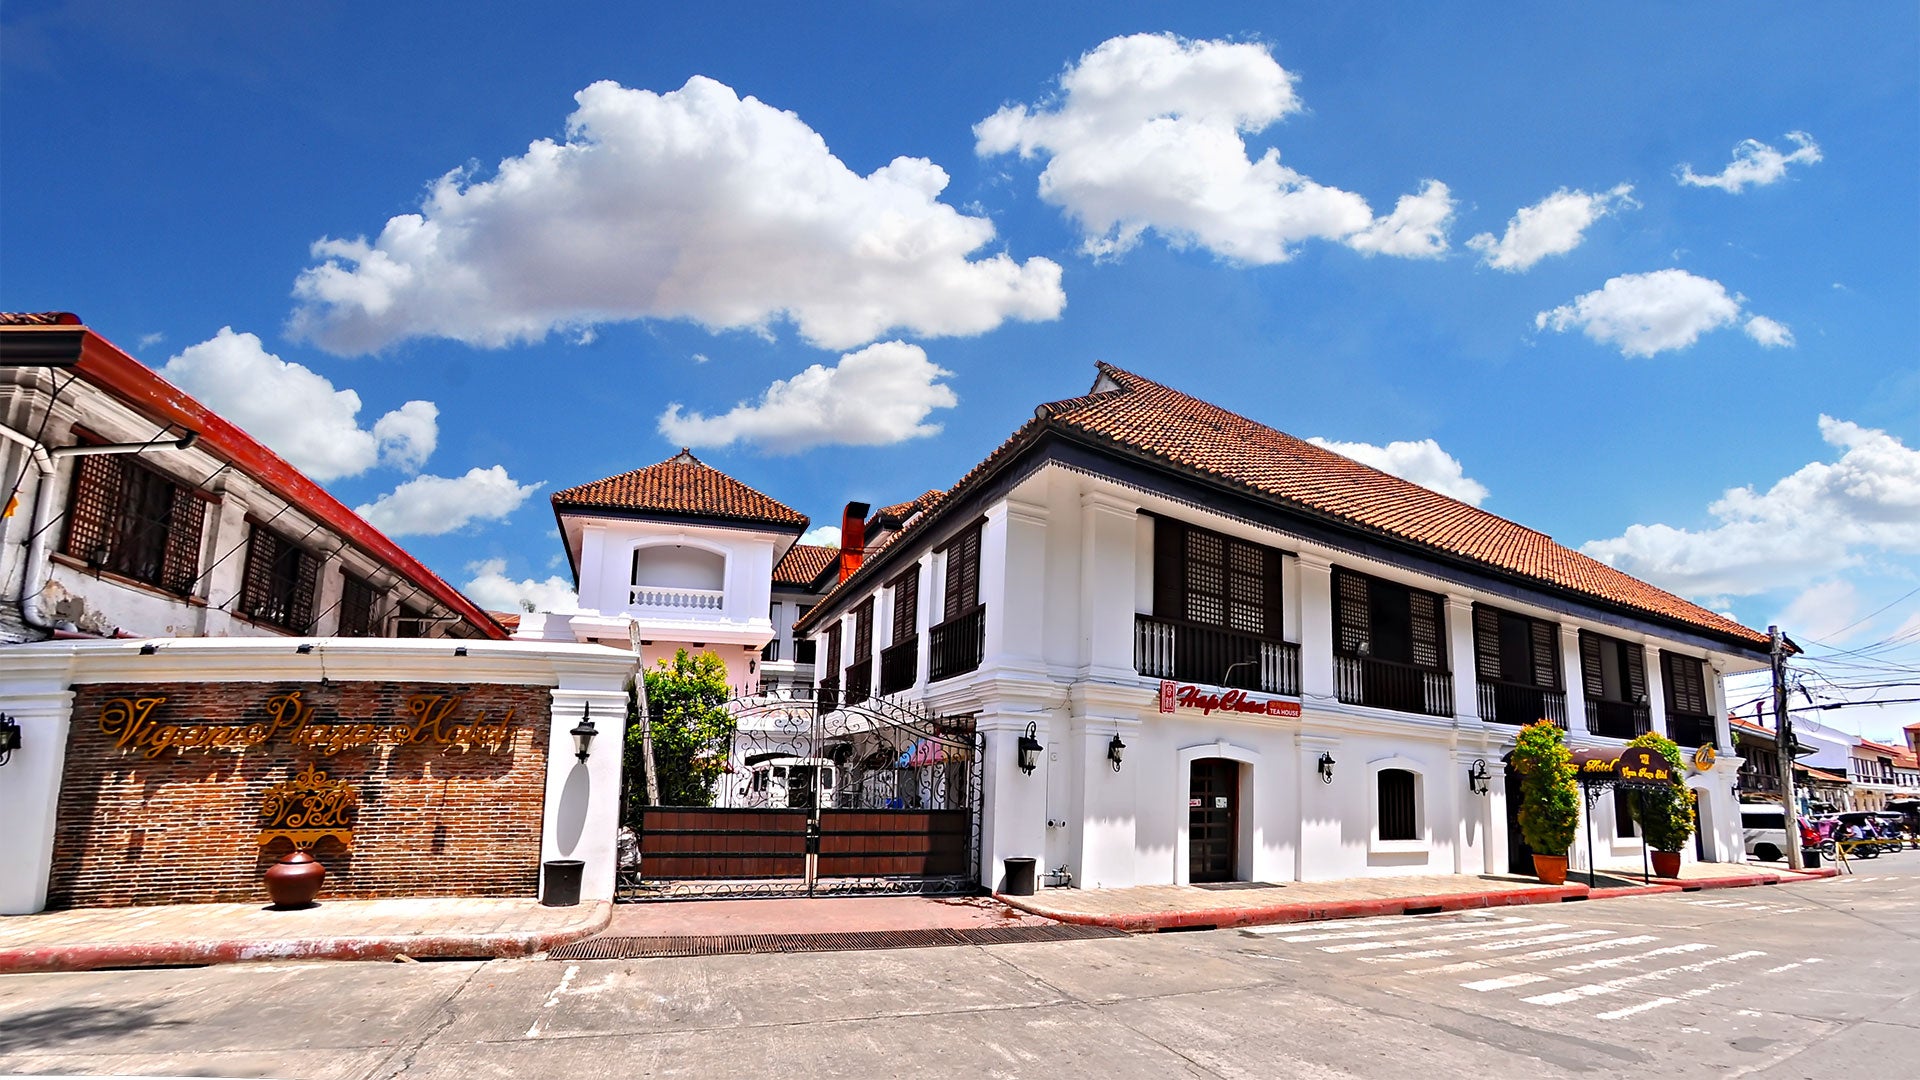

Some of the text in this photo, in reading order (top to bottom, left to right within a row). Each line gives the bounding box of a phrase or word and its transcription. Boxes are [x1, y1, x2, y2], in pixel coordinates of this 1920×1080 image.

[1176, 685, 1266, 715] Hap Chan
[1281, 709, 1299, 717] HOUSE
[99, 691, 517, 758] Vigan Plaza Hotel
[1583, 758, 1621, 772] Hotel
